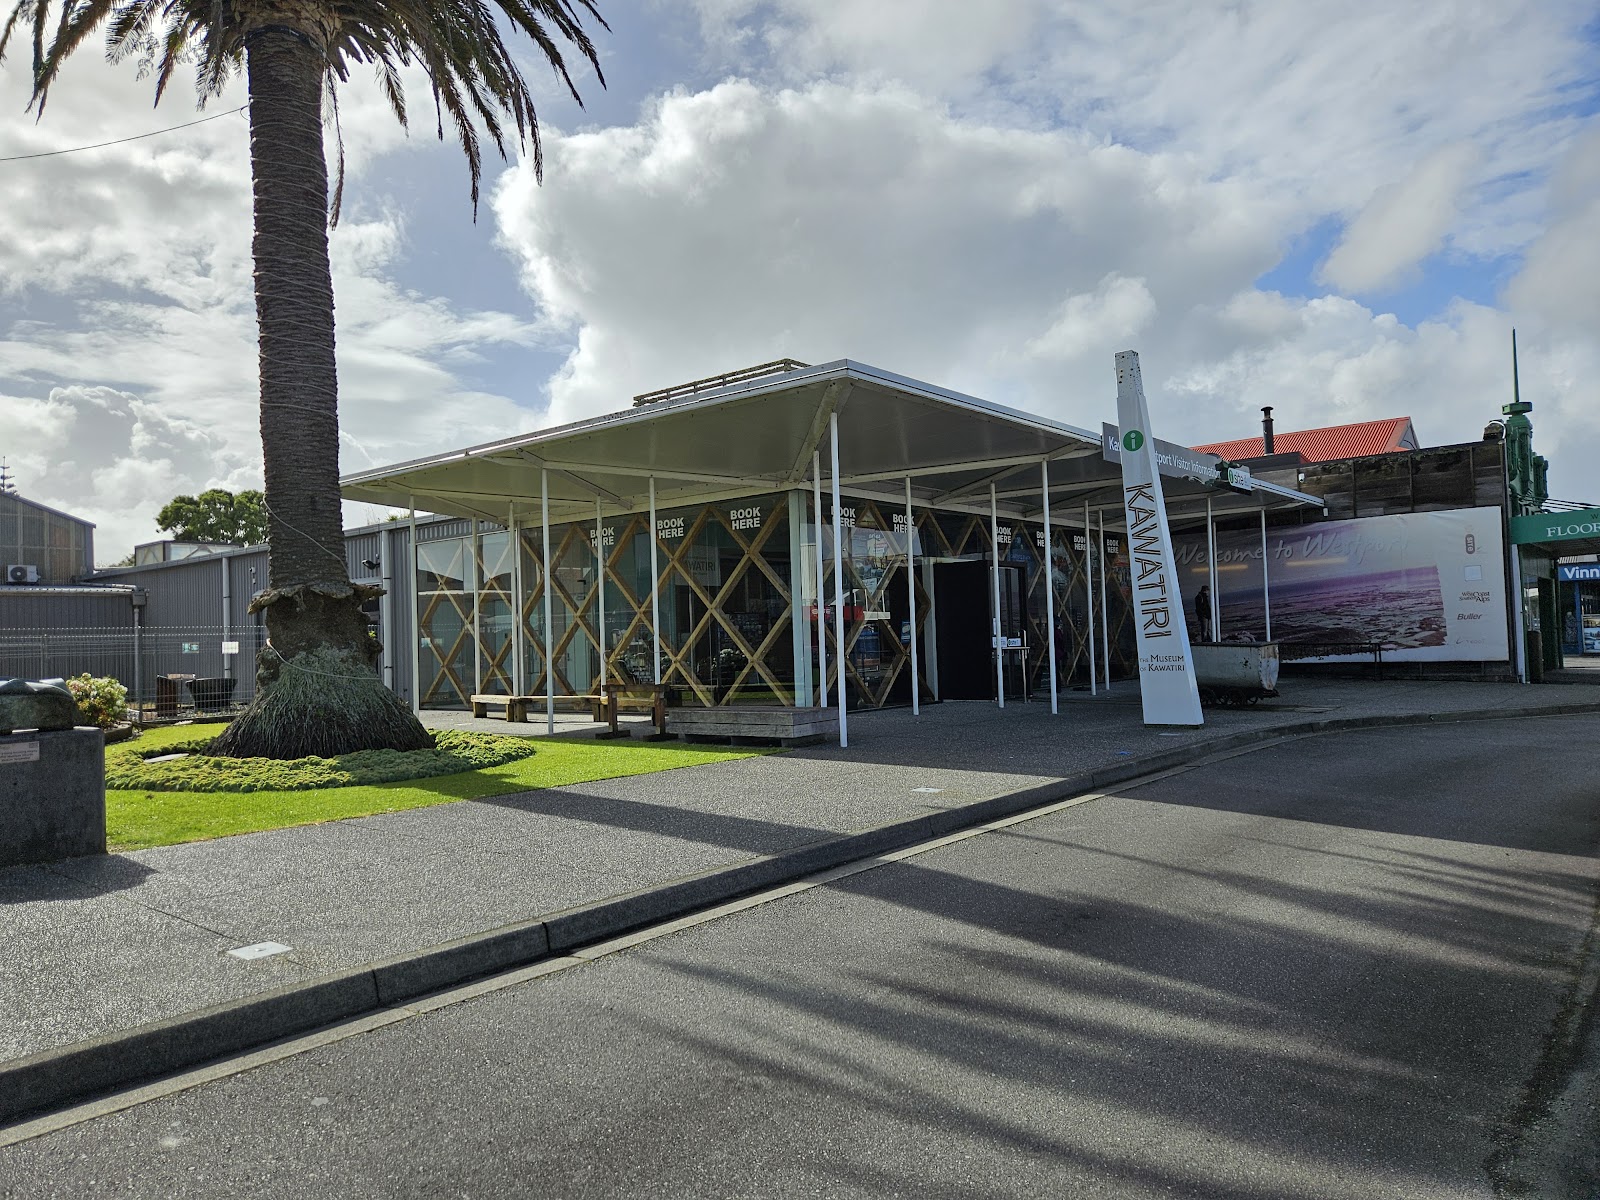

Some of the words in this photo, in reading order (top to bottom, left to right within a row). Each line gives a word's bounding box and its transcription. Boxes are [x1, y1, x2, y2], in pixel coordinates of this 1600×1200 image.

[1108, 435, 1120, 451] Ka
[1155, 450, 1172, 466] tport
[1172, 454, 1191, 471] Visitor
[1191, 460, 1222, 478] Information
[730, 506, 761, 520] BOOK
[657, 517, 685, 530] BOOK
[731, 517, 761, 530] HERE
[832, 517, 856, 528] ERE
[590, 527, 615, 538] BOK
[658, 527, 684, 540] HERE
[591, 536, 615, 547] HRE
[1106, 538, 1119, 547] BOOK
[1173, 543, 1263, 565] Wecome
[1275, 539, 1293, 559] to
[1125, 482, 1172, 639] KAWATIRI
[1564, 566, 1600, 579] Vinn
[1457, 612, 1483, 620] Buller
